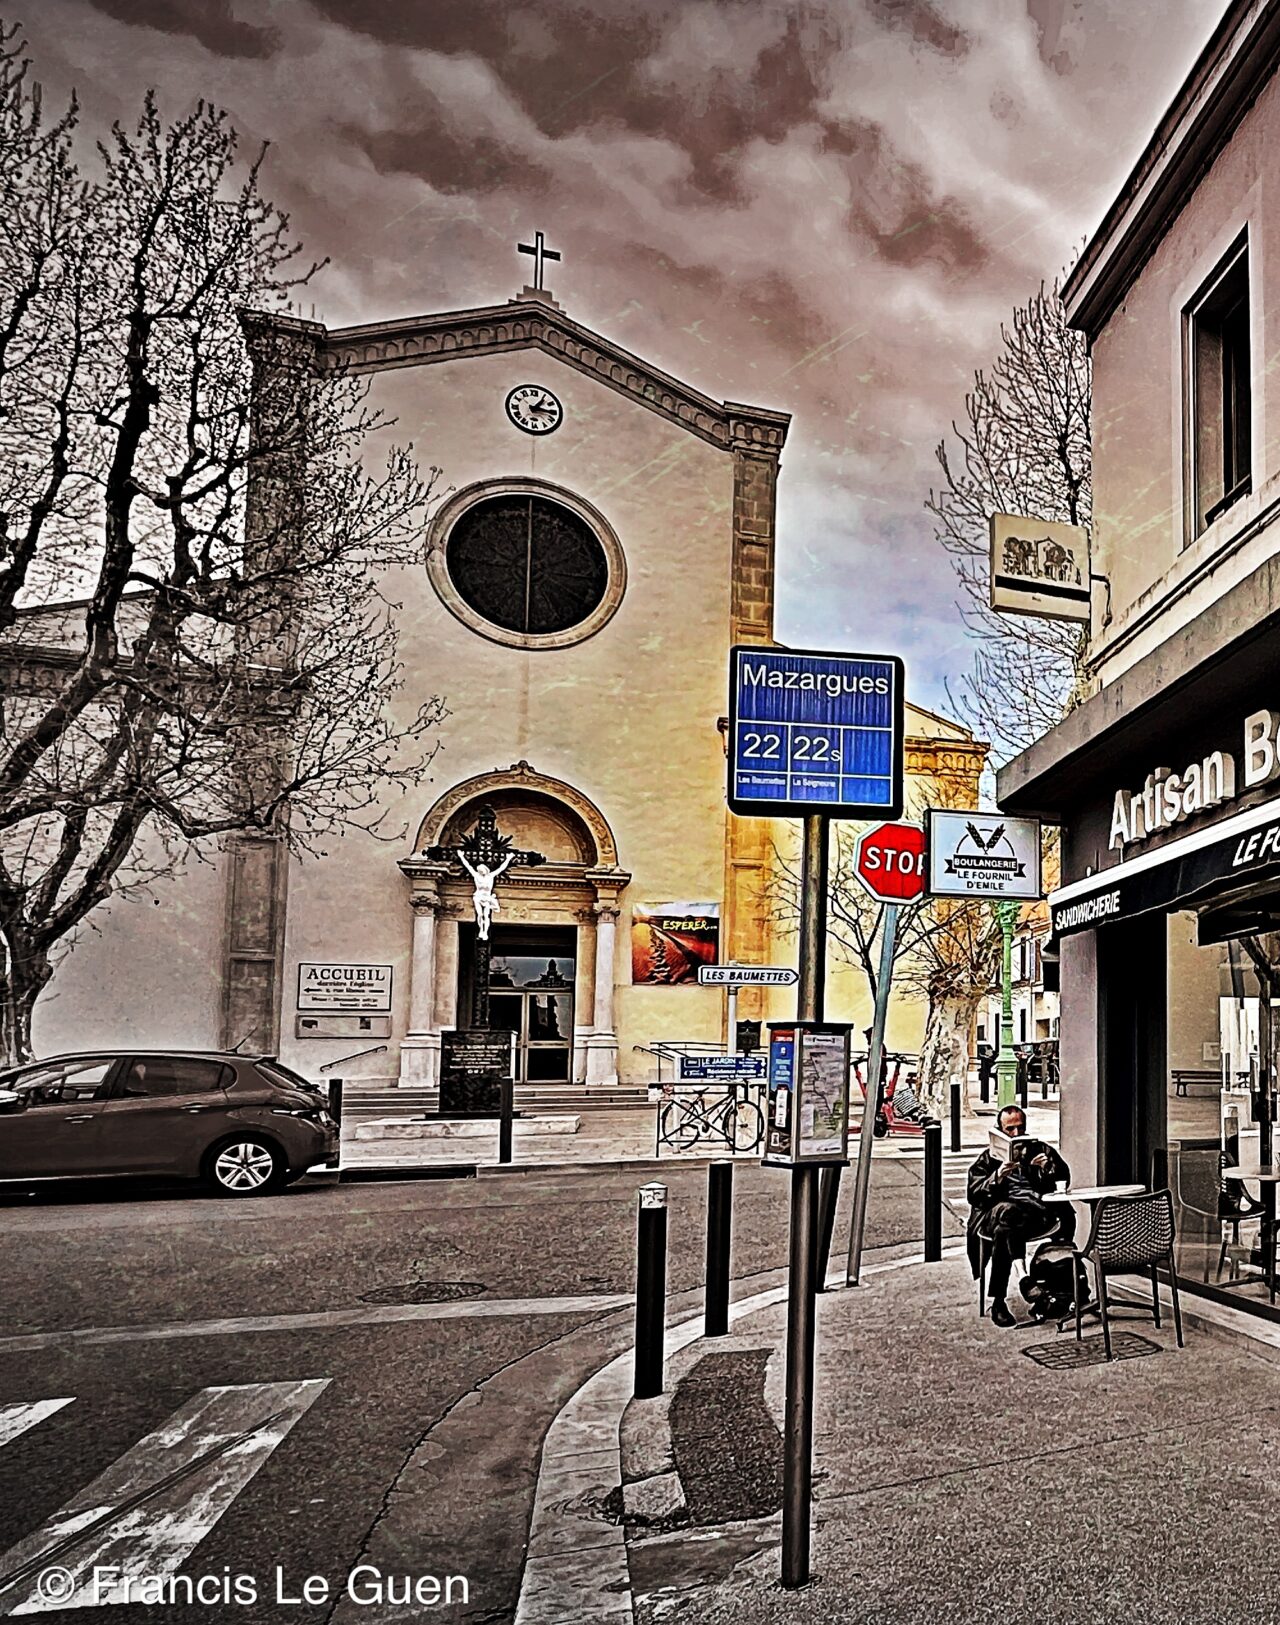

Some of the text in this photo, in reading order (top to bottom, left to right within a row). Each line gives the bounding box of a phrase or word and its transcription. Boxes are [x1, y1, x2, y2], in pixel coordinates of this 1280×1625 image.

[743, 663, 889, 697] Mazargues
[743, 733, 780, 759] 22
[793, 736, 841, 762] 22s
[1108, 747, 1236, 850] Artisan
[1232, 832, 1262, 867] LE
[954, 857, 1017, 870] BOULANGERIE
[957, 870, 1013, 881] LE FOURNIL
[967, 881, 1005, 891] D'EMILE
[1055, 890, 1121, 931] SANDWICHERIE
[307, 968, 385, 981] ACCUEIL
[706, 971, 791, 981] LES BAUMETTES
